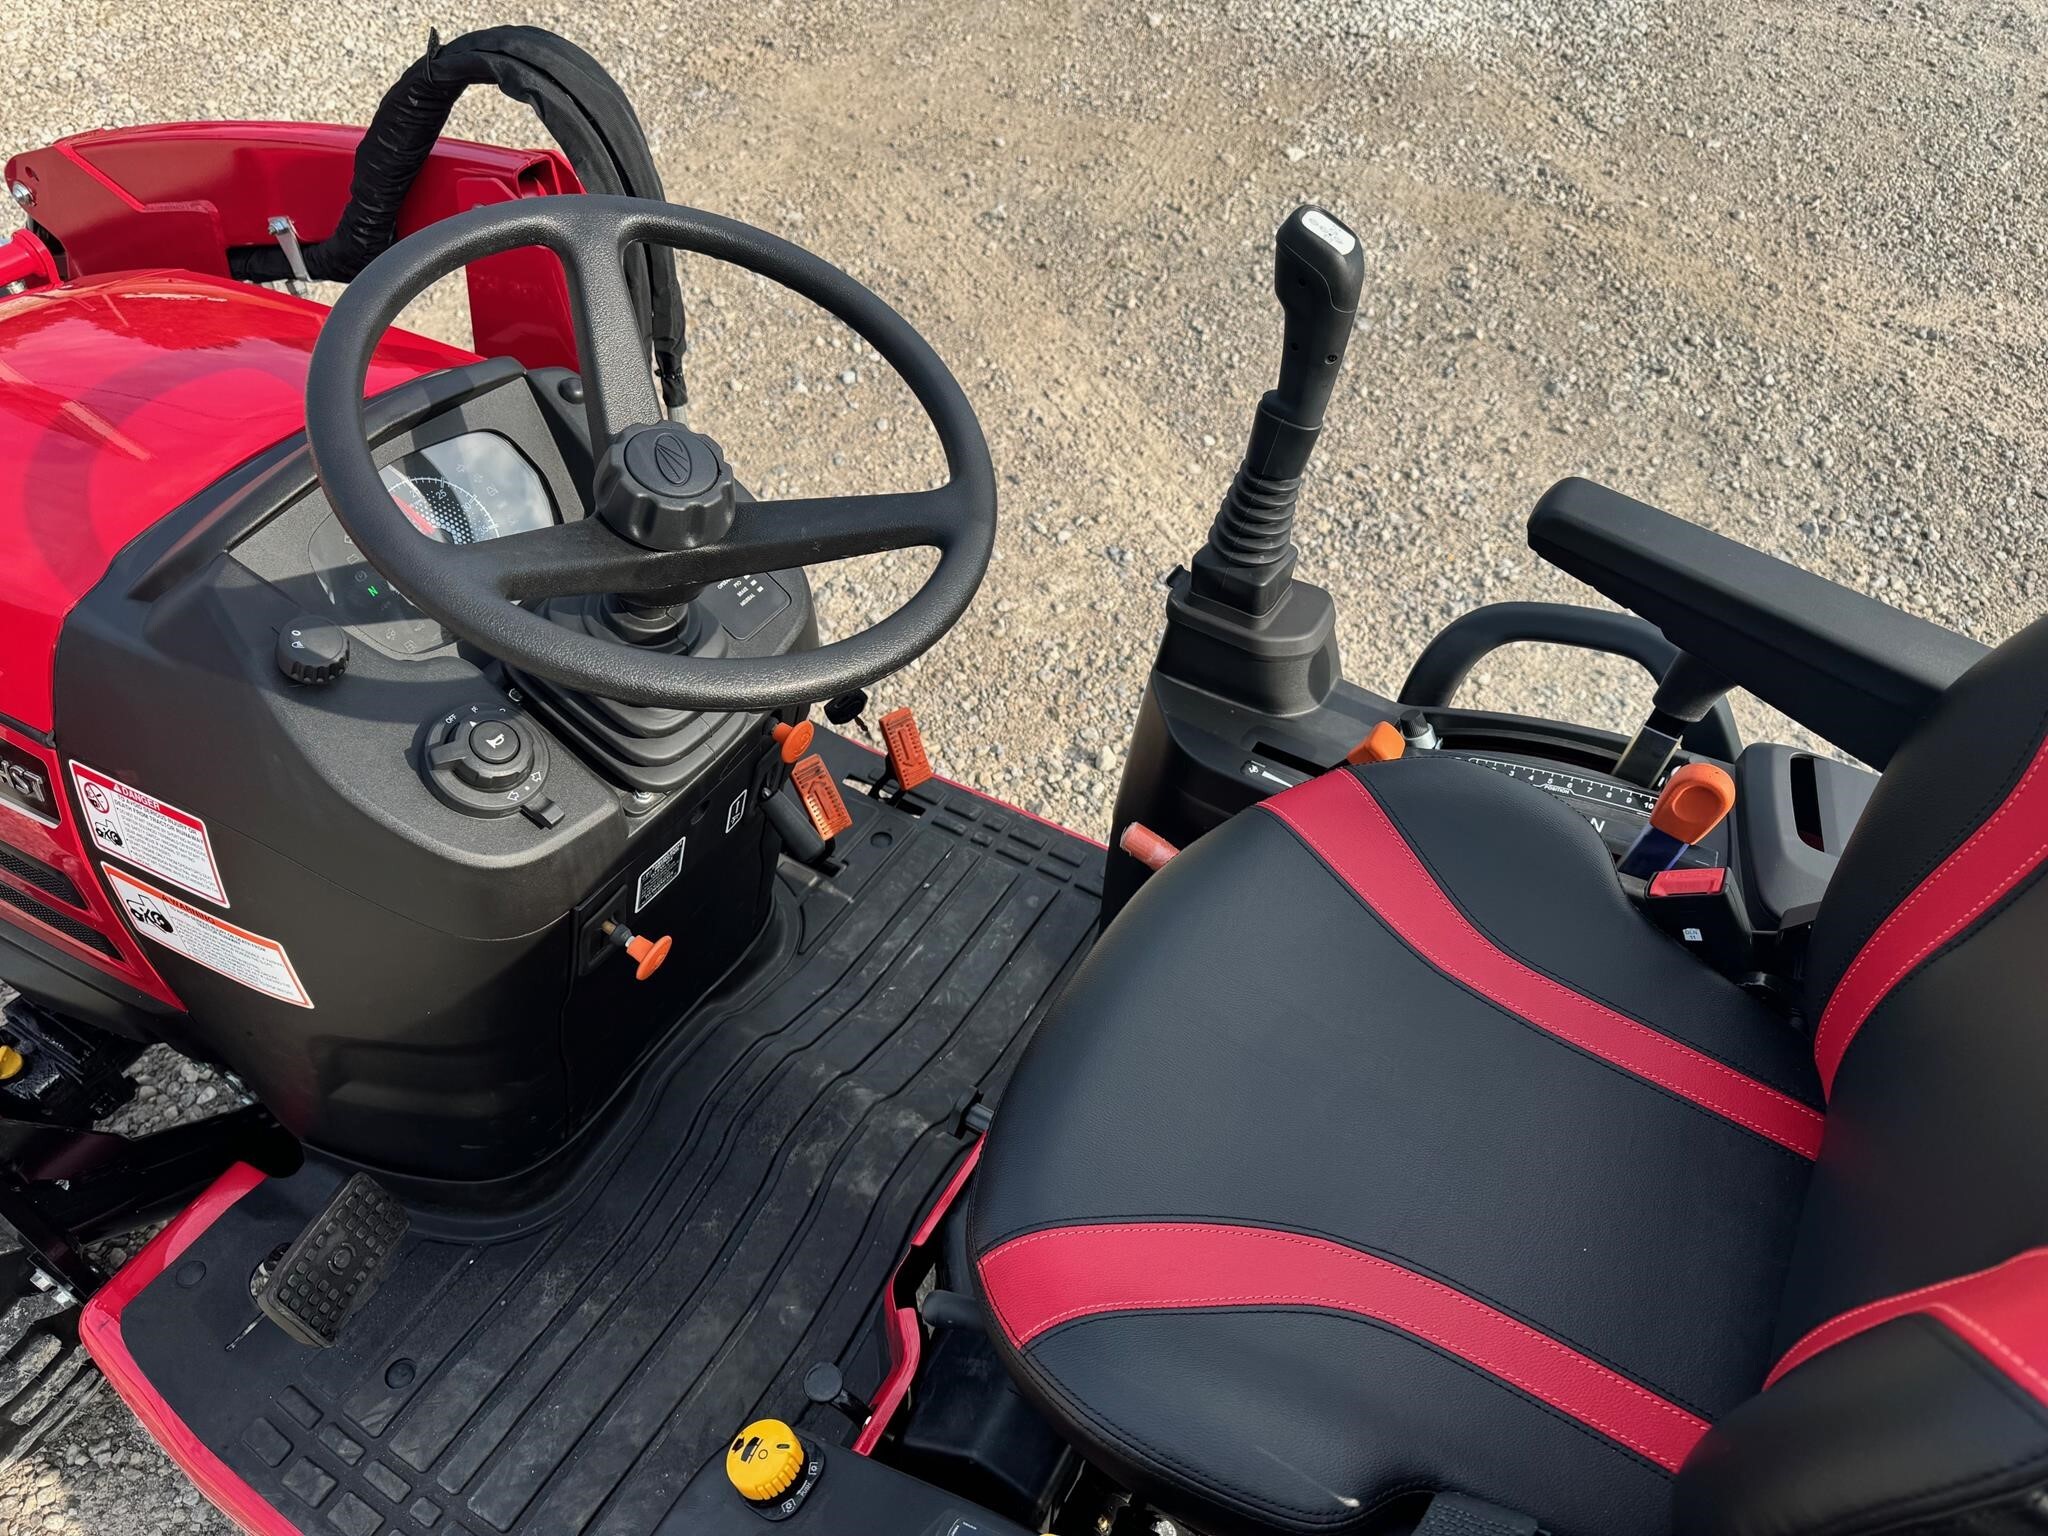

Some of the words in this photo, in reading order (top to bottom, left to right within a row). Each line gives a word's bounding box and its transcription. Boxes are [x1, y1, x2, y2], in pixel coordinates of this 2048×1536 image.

[435, 489, 447, 500] 25
[367, 585, 379, 598] N
[445, 713, 457, 724] OFF
[1543, 784, 1570, 794] POSITION
[122, 787, 160, 811] DANGER
[168, 897, 216, 925] WARNING
[800, 1482, 812, 1498] PUSH
